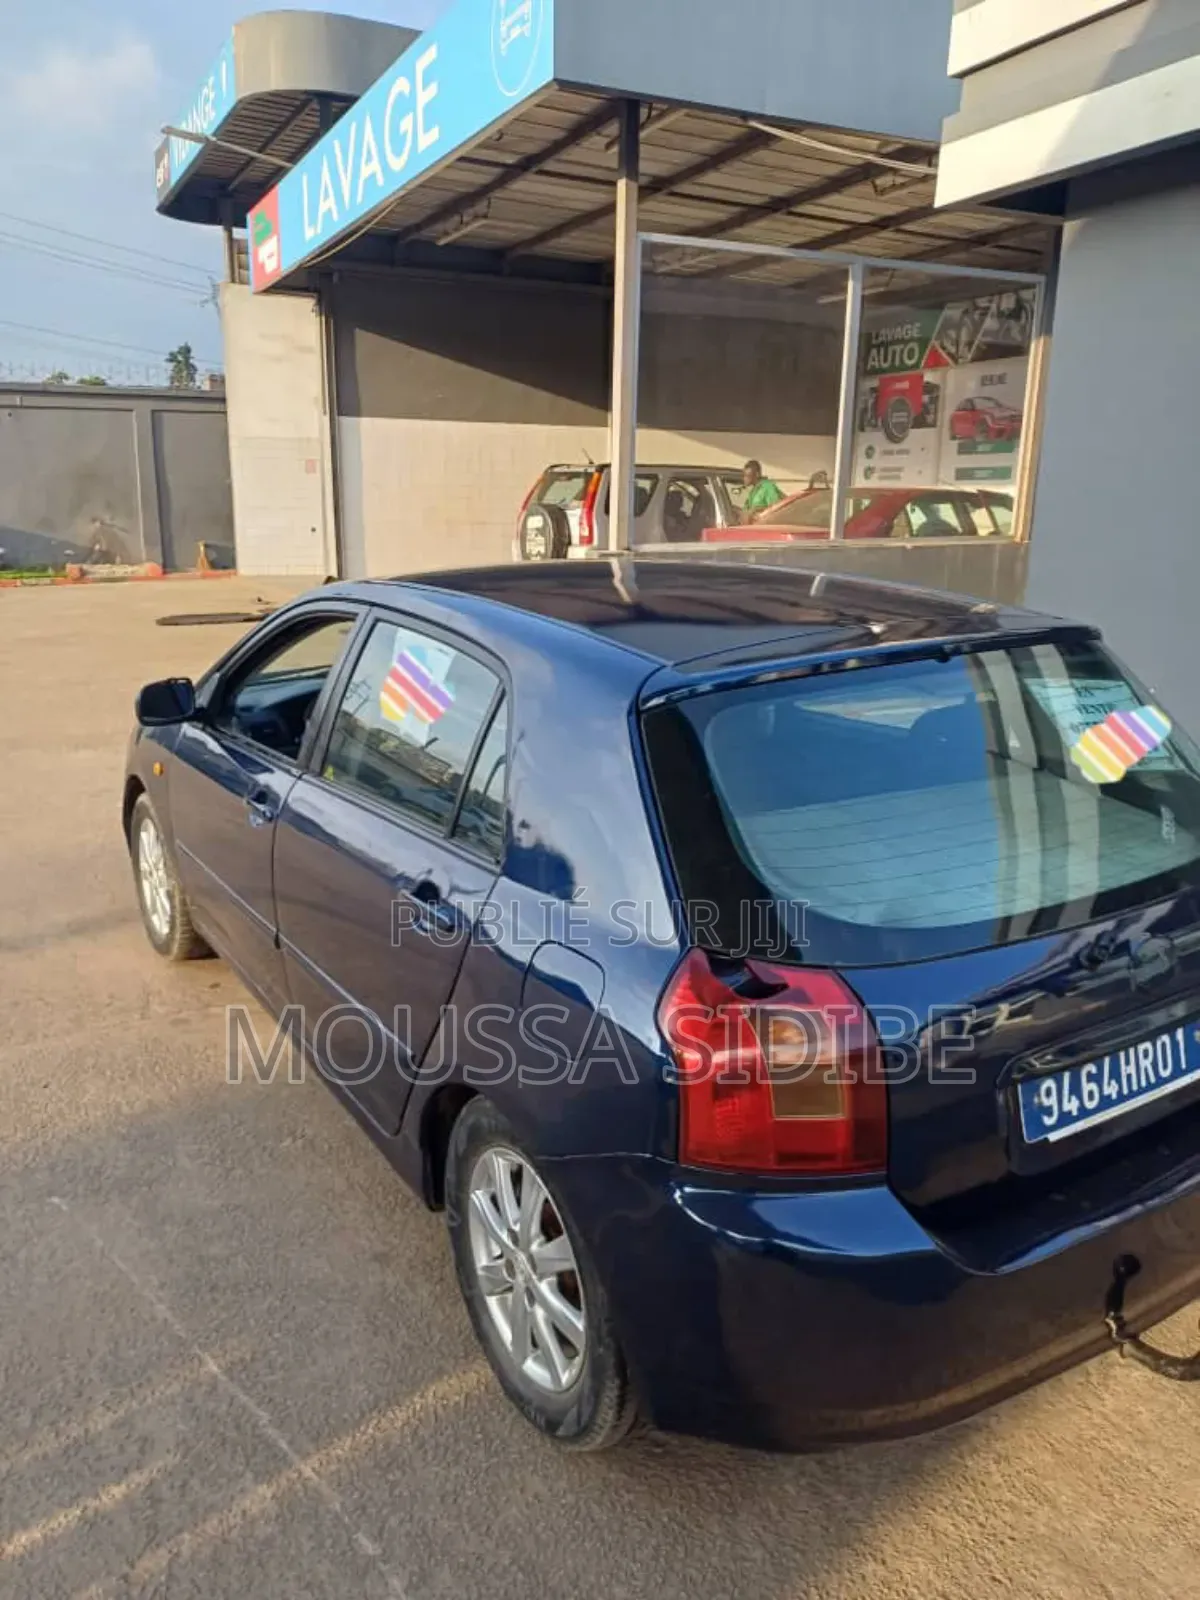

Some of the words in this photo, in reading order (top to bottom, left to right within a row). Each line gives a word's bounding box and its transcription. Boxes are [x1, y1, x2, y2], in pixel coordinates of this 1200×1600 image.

[302, 42, 440, 242] LAVAGE
[866, 341, 920, 371] AUTO
[871, 321, 922, 346] LAVAGE
[1040, 1027, 1188, 1127] 9464HR01
